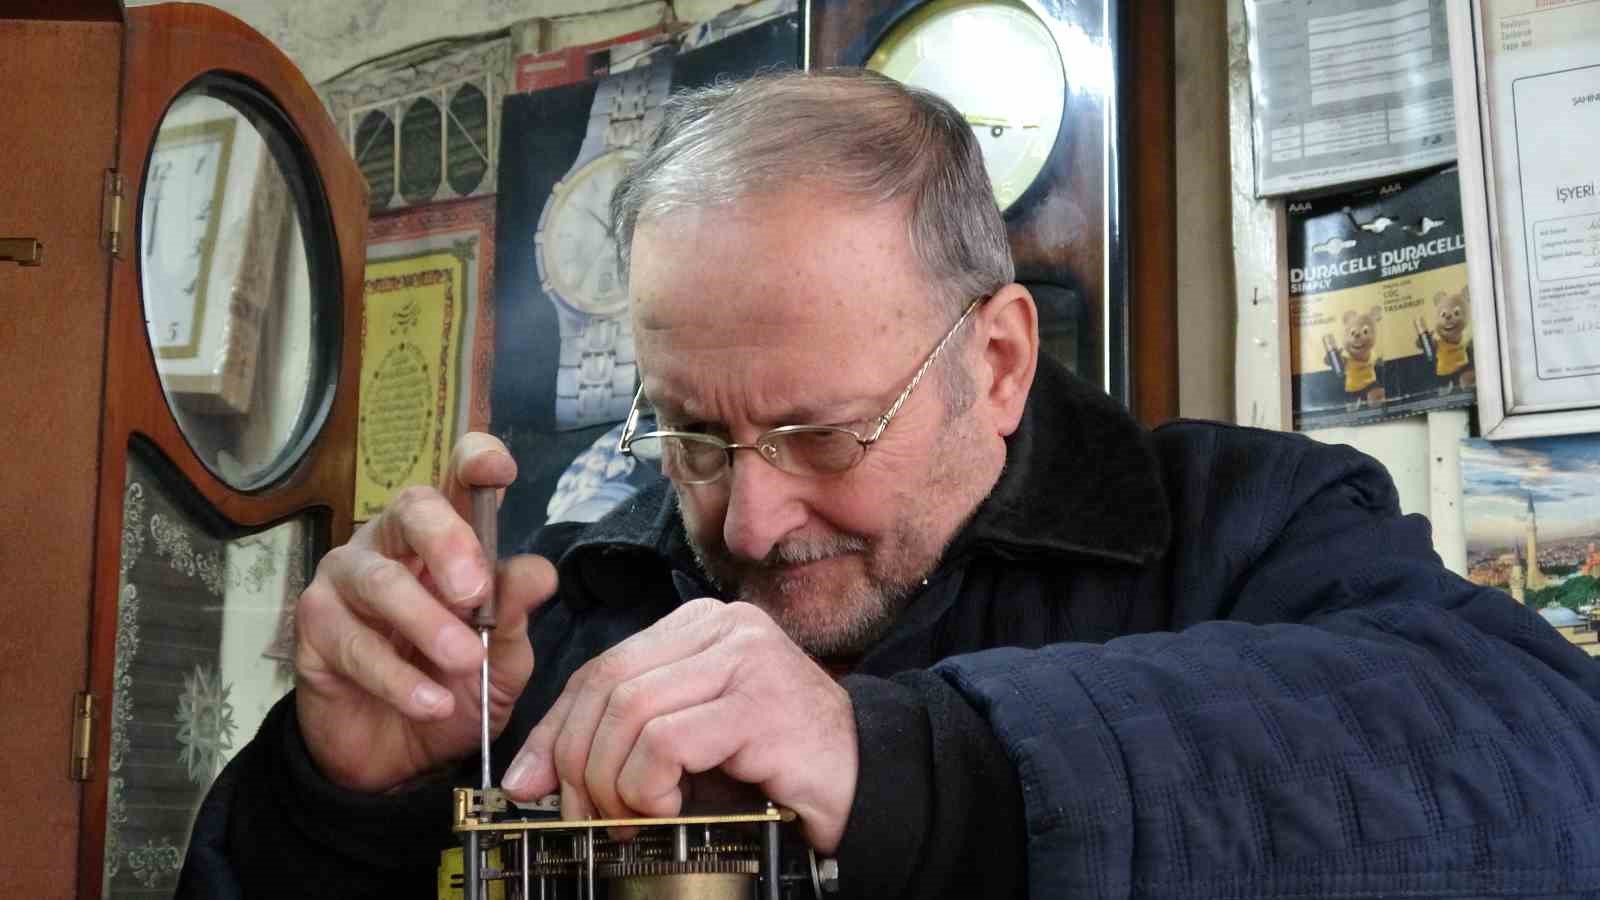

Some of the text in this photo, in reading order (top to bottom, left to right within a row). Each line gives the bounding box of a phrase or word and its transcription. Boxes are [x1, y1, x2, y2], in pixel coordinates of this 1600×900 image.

[1288, 202, 1312, 213] AAA
[1381, 235, 1465, 266] DURACELL
[1290, 255, 1376, 283] DURACELL
[1381, 259, 1420, 277] SIMPLY
[1291, 278, 1332, 293] SIMPLY
